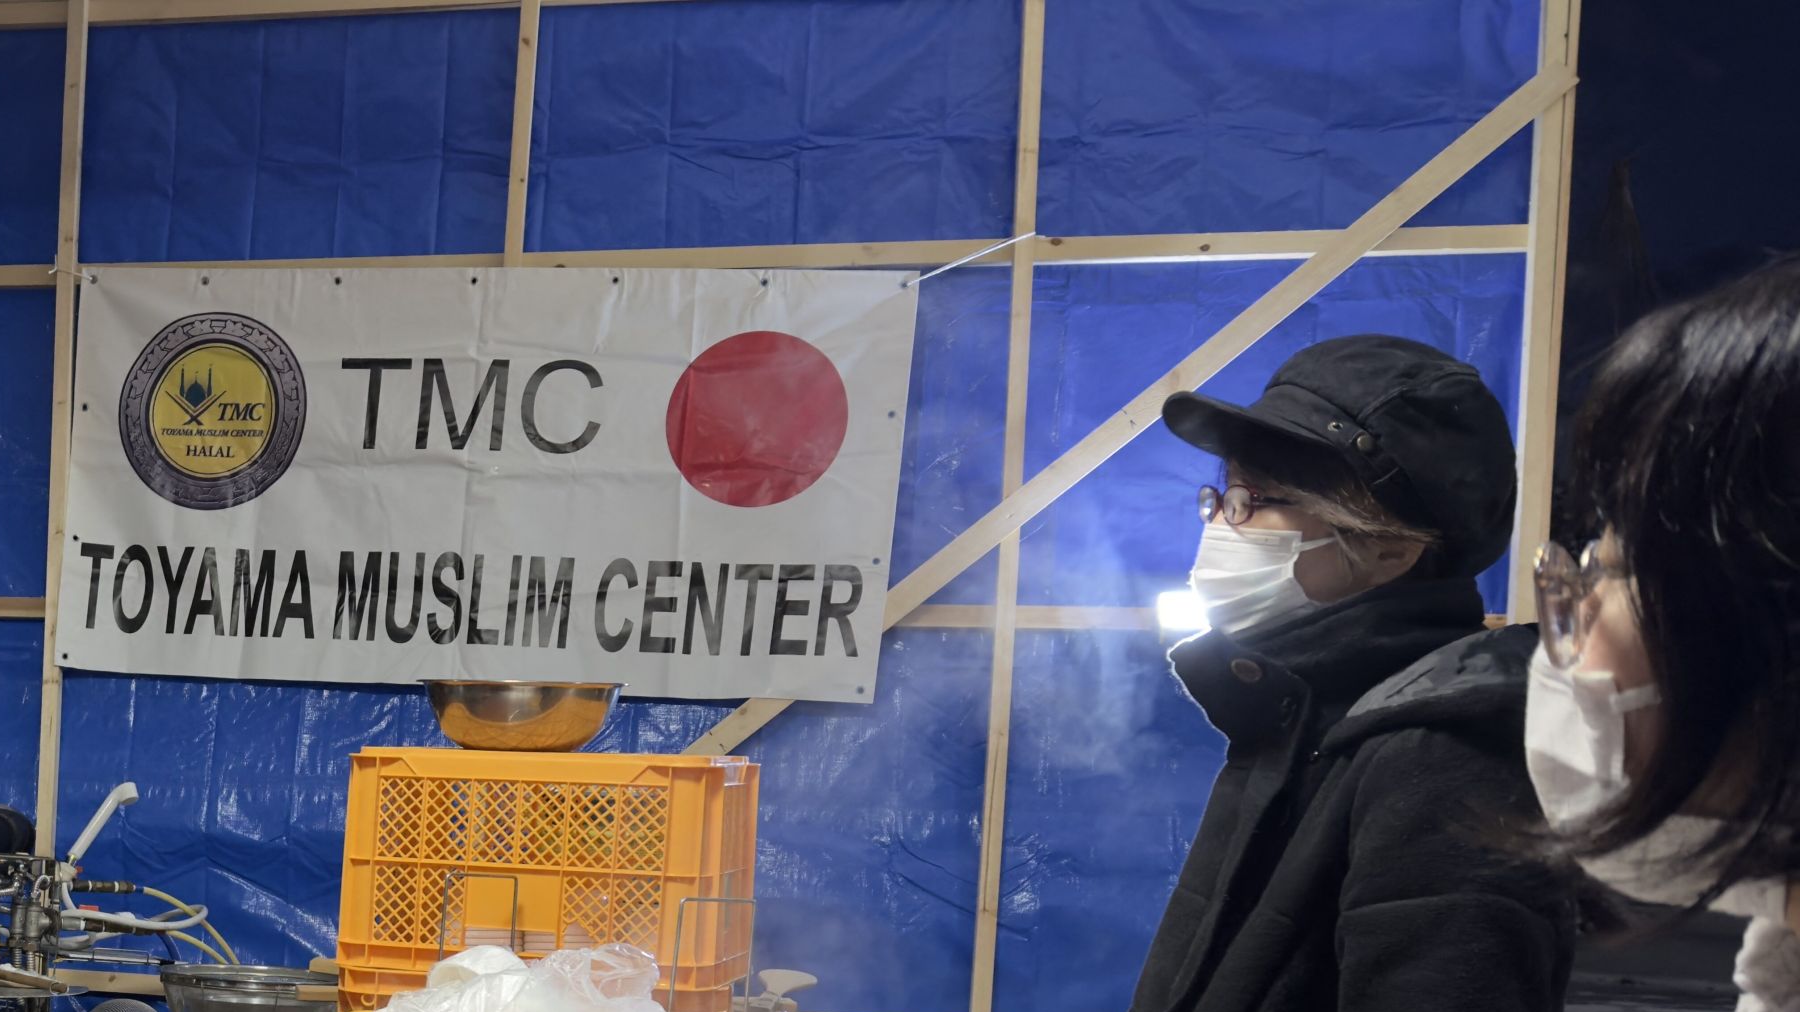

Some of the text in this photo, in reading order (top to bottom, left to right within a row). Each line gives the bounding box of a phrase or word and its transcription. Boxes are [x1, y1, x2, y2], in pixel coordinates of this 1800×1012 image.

[217, 402, 266, 421] TMC
[342, 357, 604, 455] TMC
[161, 427, 264, 438] TOYAMA MUSLIM CENTER
[186, 445, 235, 458] HALAL
[80, 542, 864, 657] TOYAMA MUSLIM CENTER
